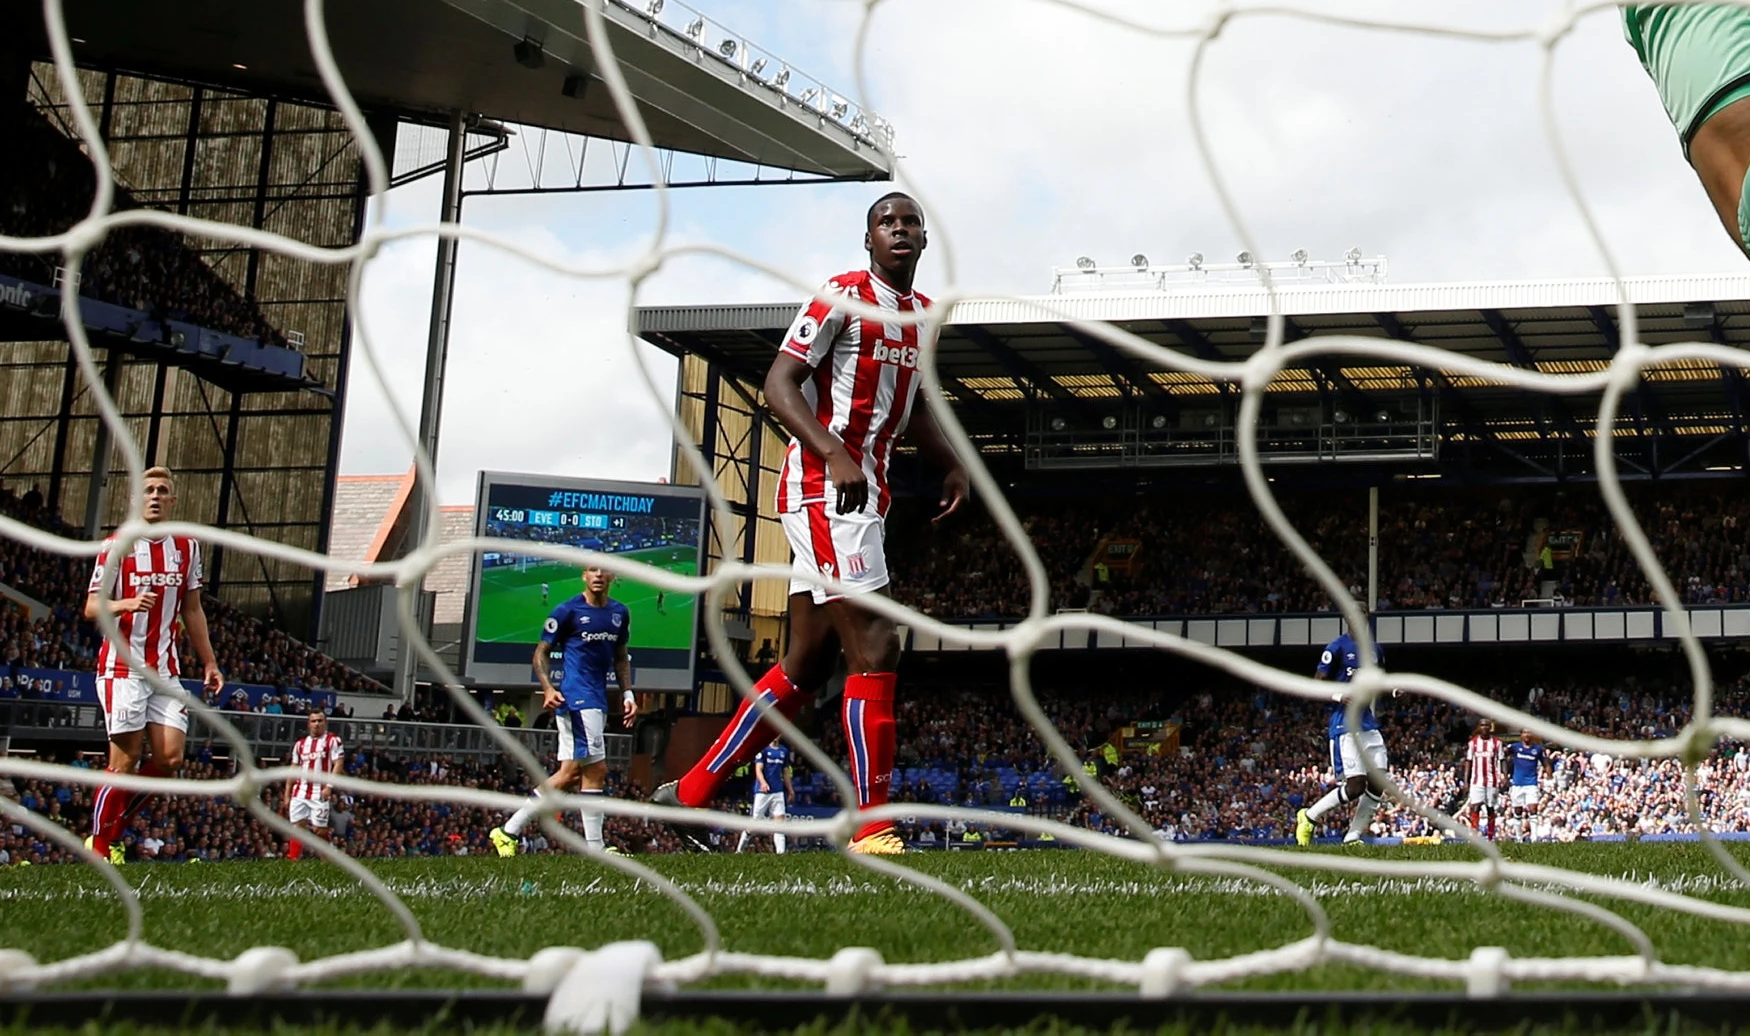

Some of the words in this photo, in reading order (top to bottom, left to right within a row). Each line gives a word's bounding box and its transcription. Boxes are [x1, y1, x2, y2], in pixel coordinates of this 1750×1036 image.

[873, 339, 921, 370] bet3
[548, 492, 654, 513] #EFCMATCHDAY
[496, 509, 524, 522] 45:00
[534, 512, 553, 524] EVE
[129, 572, 183, 586] bet365
